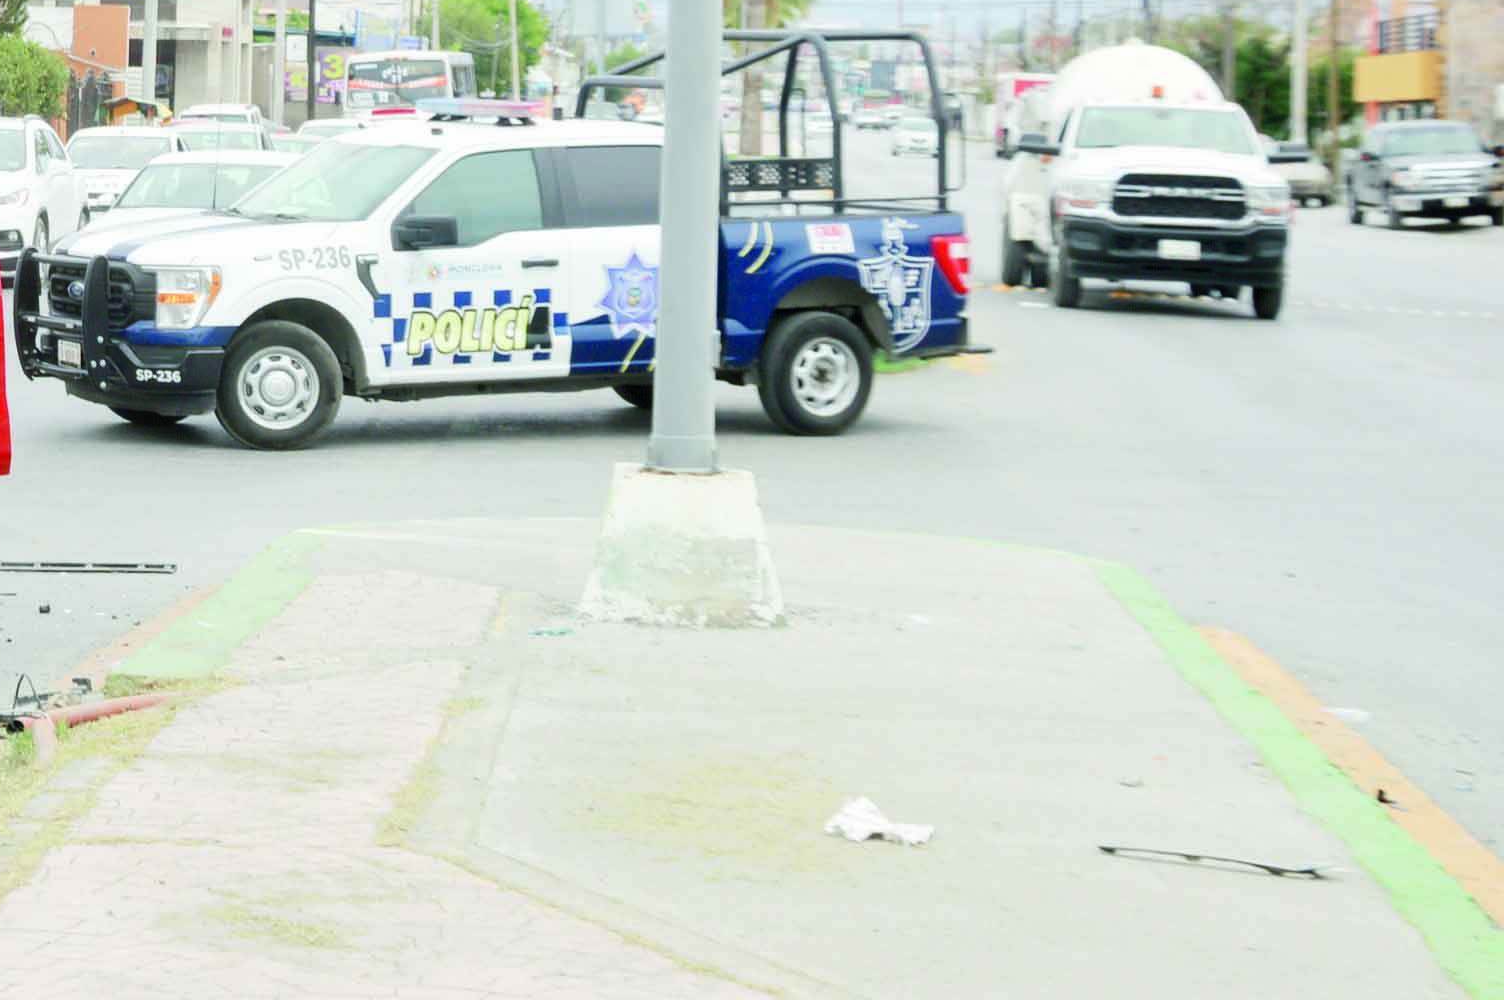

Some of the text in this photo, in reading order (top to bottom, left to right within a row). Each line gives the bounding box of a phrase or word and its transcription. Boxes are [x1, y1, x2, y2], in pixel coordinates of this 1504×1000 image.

[278, 244, 351, 271] SP-236
[407, 294, 552, 355] POLICÍA
[136, 368, 182, 384] SP-236
